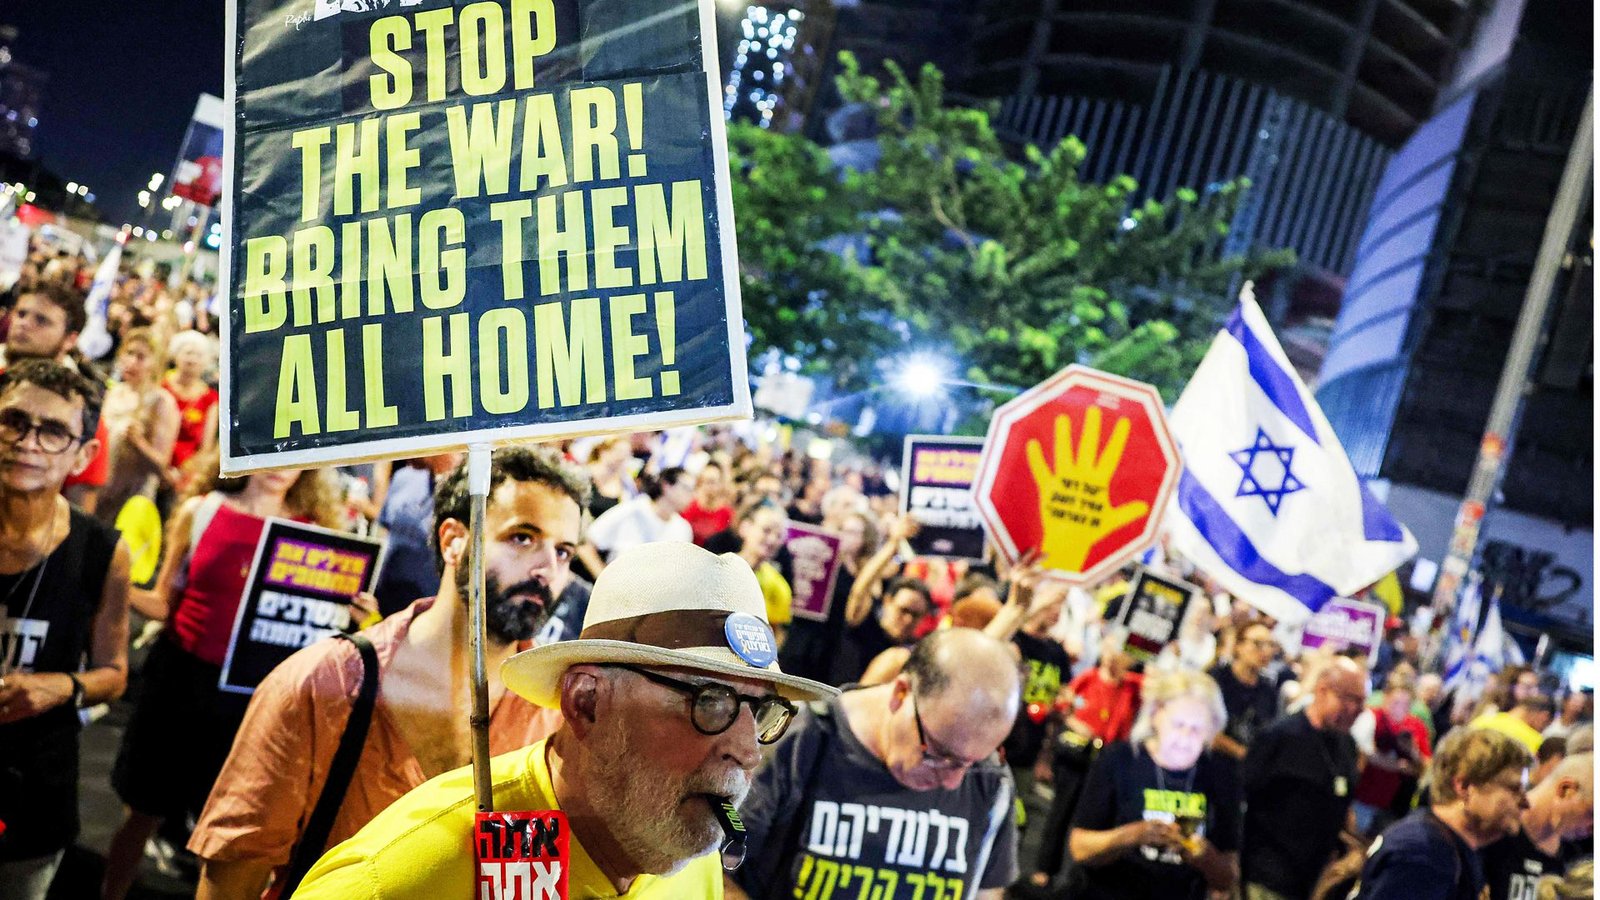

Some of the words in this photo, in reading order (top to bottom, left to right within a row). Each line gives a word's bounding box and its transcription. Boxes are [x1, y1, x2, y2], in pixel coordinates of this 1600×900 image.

[370, 0, 557, 110] STOP
[292, 112, 422, 223] THE
[446, 83, 647, 200] WAR!
[244, 207, 467, 334] BRING
[490, 179, 708, 301] THEM
[273, 323, 399, 439] ALL
[422, 291, 681, 422] HOME!
[480, 817, 560, 858] אתה
[480, 860, 561, 900] אתה
[807, 800, 969, 875] בלעדיהם
